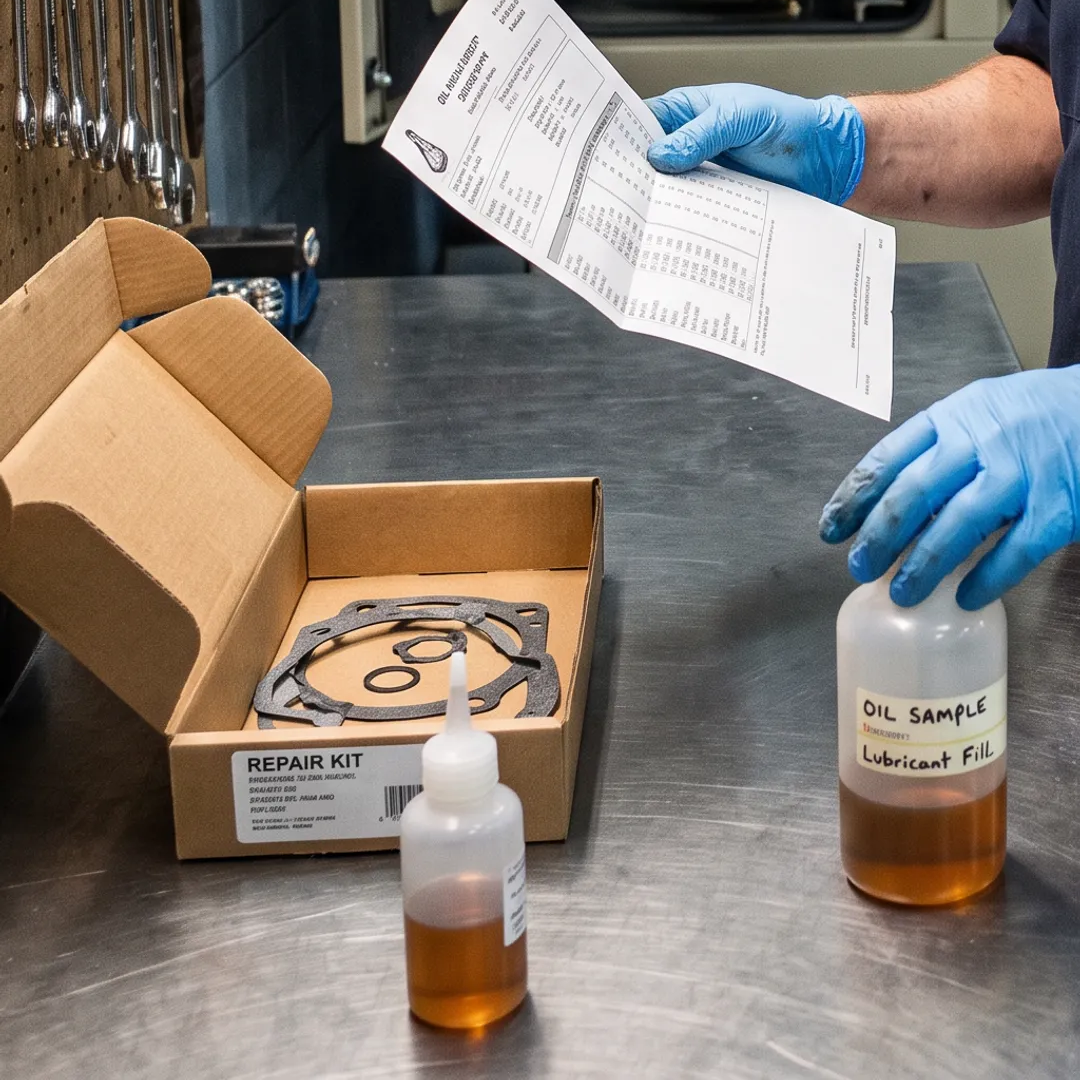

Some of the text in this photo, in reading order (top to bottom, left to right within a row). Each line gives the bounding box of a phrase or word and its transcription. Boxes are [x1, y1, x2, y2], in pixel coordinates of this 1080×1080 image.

[863, 695, 987, 727] OIL SAMPLE
[247, 753, 363, 773] REPAIR KIT
[863, 740, 994, 770] Lubricant Fill
